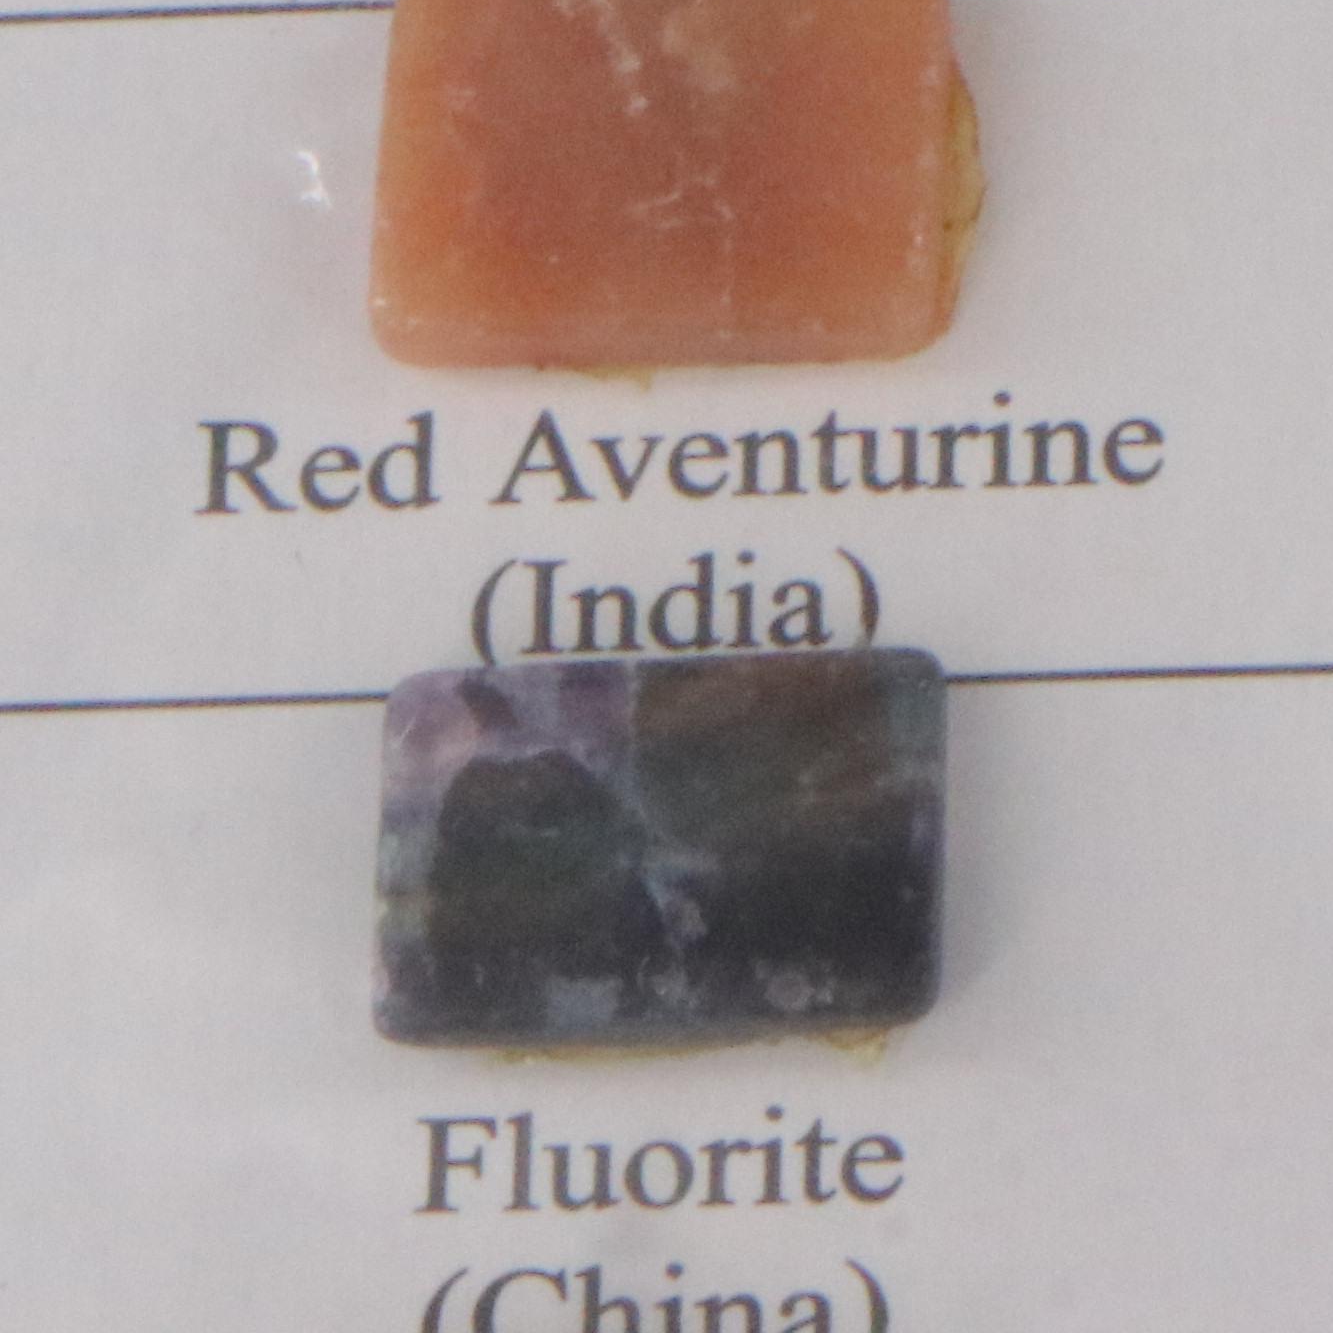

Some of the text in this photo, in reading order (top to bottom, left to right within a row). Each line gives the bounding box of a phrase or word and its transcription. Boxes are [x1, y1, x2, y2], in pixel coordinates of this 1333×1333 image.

[195, 390, 1165, 516] Red Aventurine
[470, 548, 885, 668] (India)
[418, 1106, 905, 1214] Fluorite
